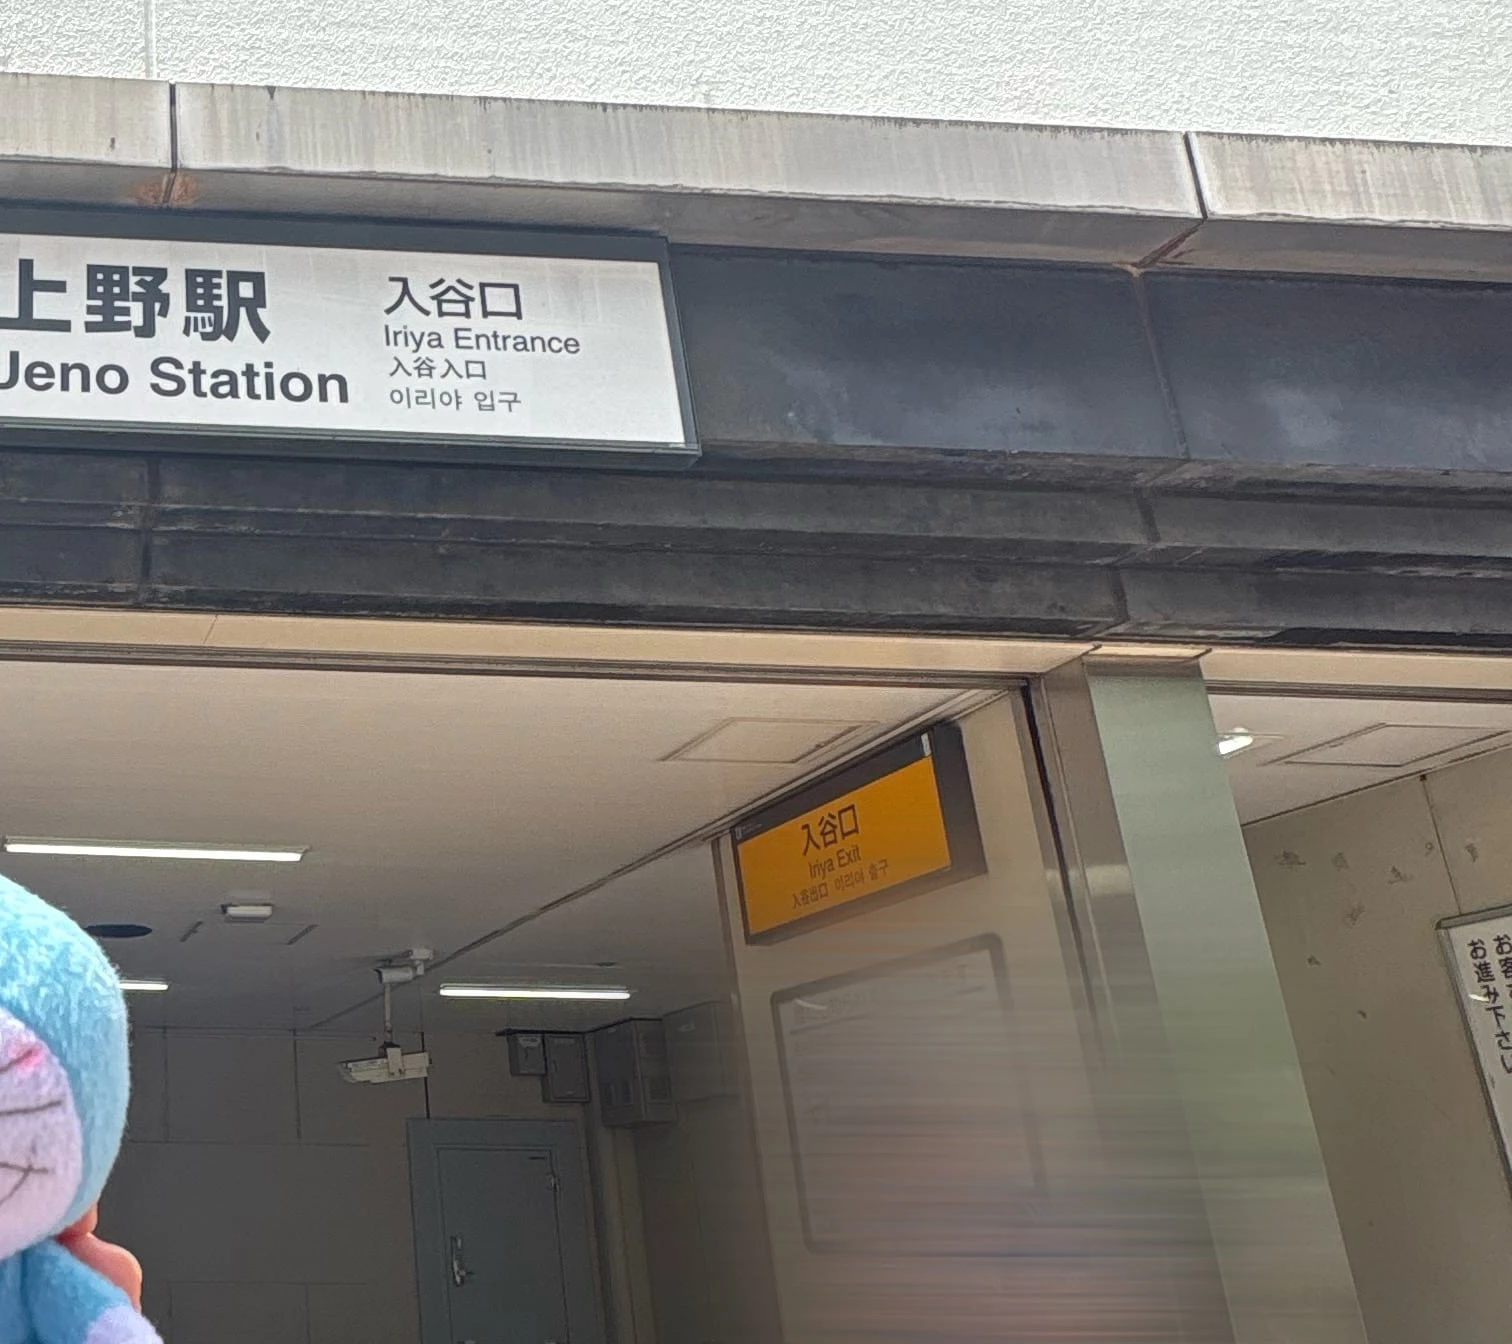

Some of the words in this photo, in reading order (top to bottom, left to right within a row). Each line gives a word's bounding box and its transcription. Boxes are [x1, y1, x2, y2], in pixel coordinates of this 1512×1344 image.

[384, 276, 523, 320] 入谷口
[384, 325, 444, 353] Iriya
[454, 327, 580, 354] Entrance
[149, 356, 349, 403] Station
[389, 356, 487, 380] 入谷入口
[389, 388, 463, 410] 이리야
[474, 391, 521, 412] 입구
[801, 804, 859, 856] 入谷口
[808, 857, 835, 880] Iriya
[836, 844, 861, 868] Exit
[1492, 933, 1512, 1000] お客
